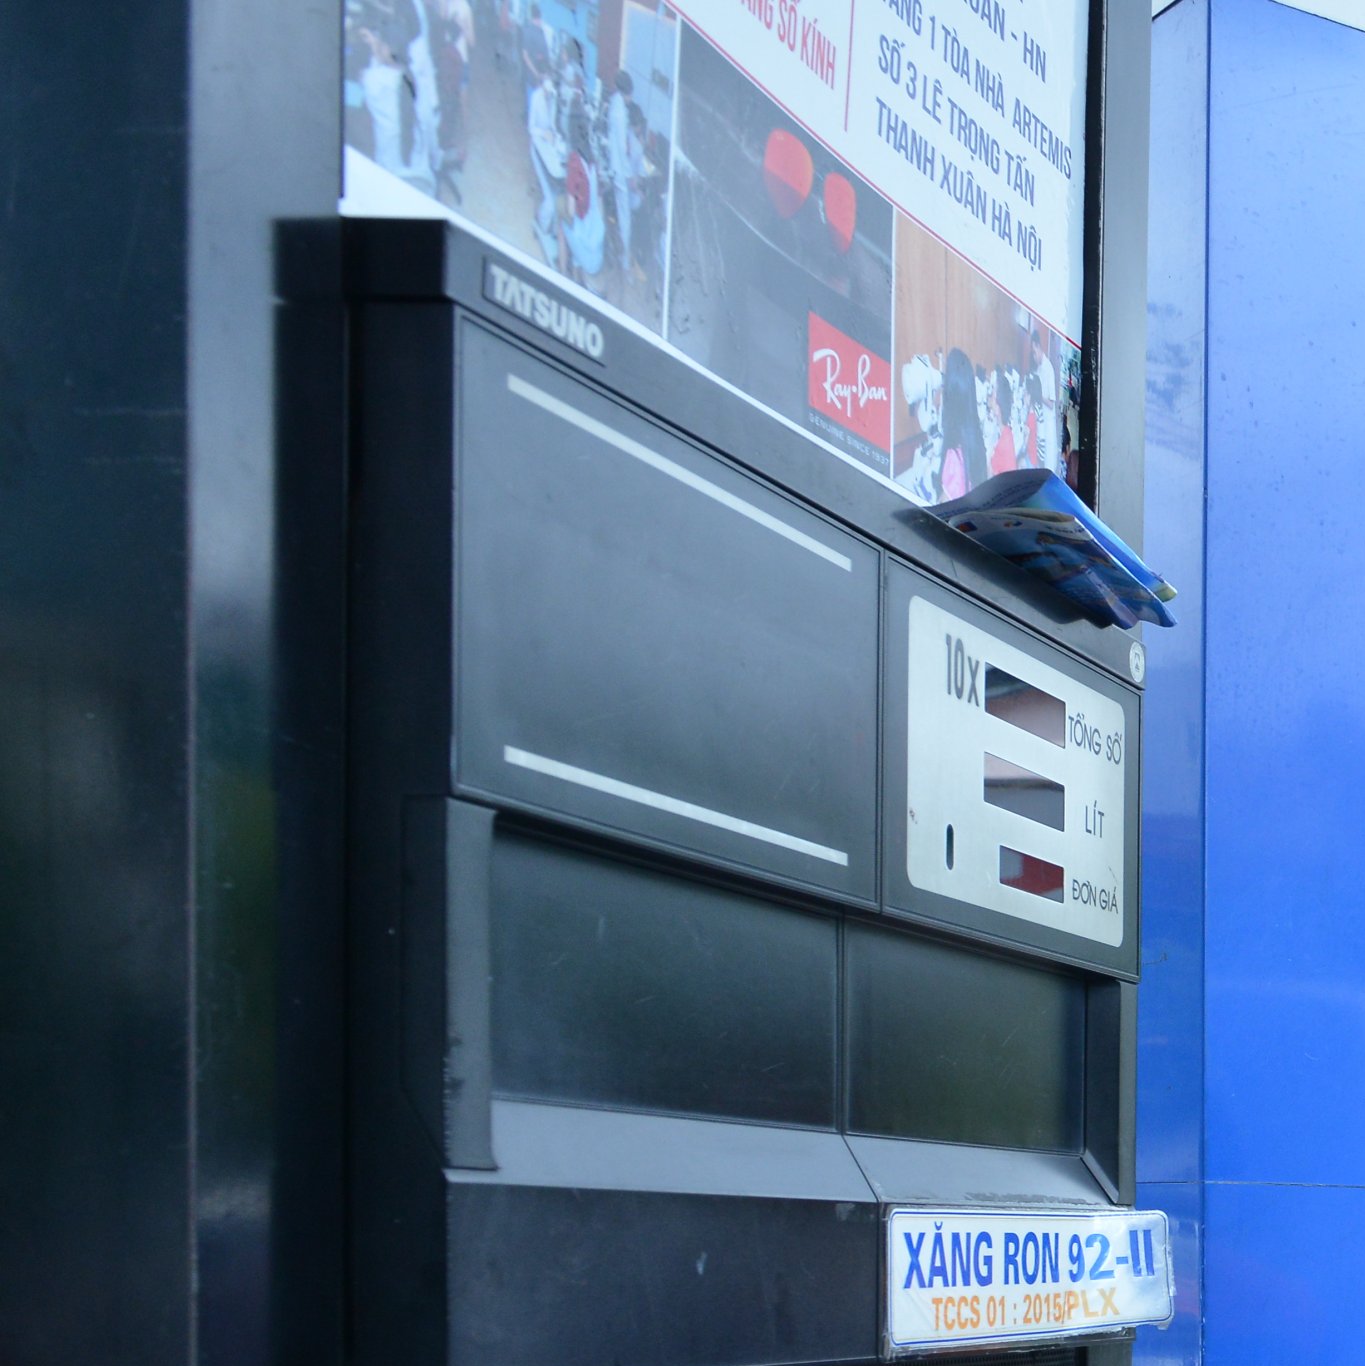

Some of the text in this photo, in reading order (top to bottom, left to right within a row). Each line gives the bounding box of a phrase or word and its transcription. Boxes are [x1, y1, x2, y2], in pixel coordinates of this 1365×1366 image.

[800, 16, 836, 90] KÍNH
[1022, 31, 1046, 83] HN
[878, 34, 1035, 208] SỐ 3 LÊ TRỌNG TẤN
[929, 15, 936, 50] 1
[941, 24, 971, 85] TÒA
[975, 58, 1005, 119] NHÀ
[1012, 97, 1072, 180] ARTEMIS
[876, 96, 1042, 272] THANH XUÂN HÀ NỘI
[490, 263, 604, 358] TATSUNO
[1067, 712, 1123, 765] TỔNG SỐ
[1084, 801, 1105, 839] LÍT
[1072, 879, 1119, 914] ĐƠN GIÁ
[903, 1221, 1155, 1289] XĂNG RON 92-II
[932, 1295, 981, 1331] TCCS
[986, 1295, 1006, 1327] 01
